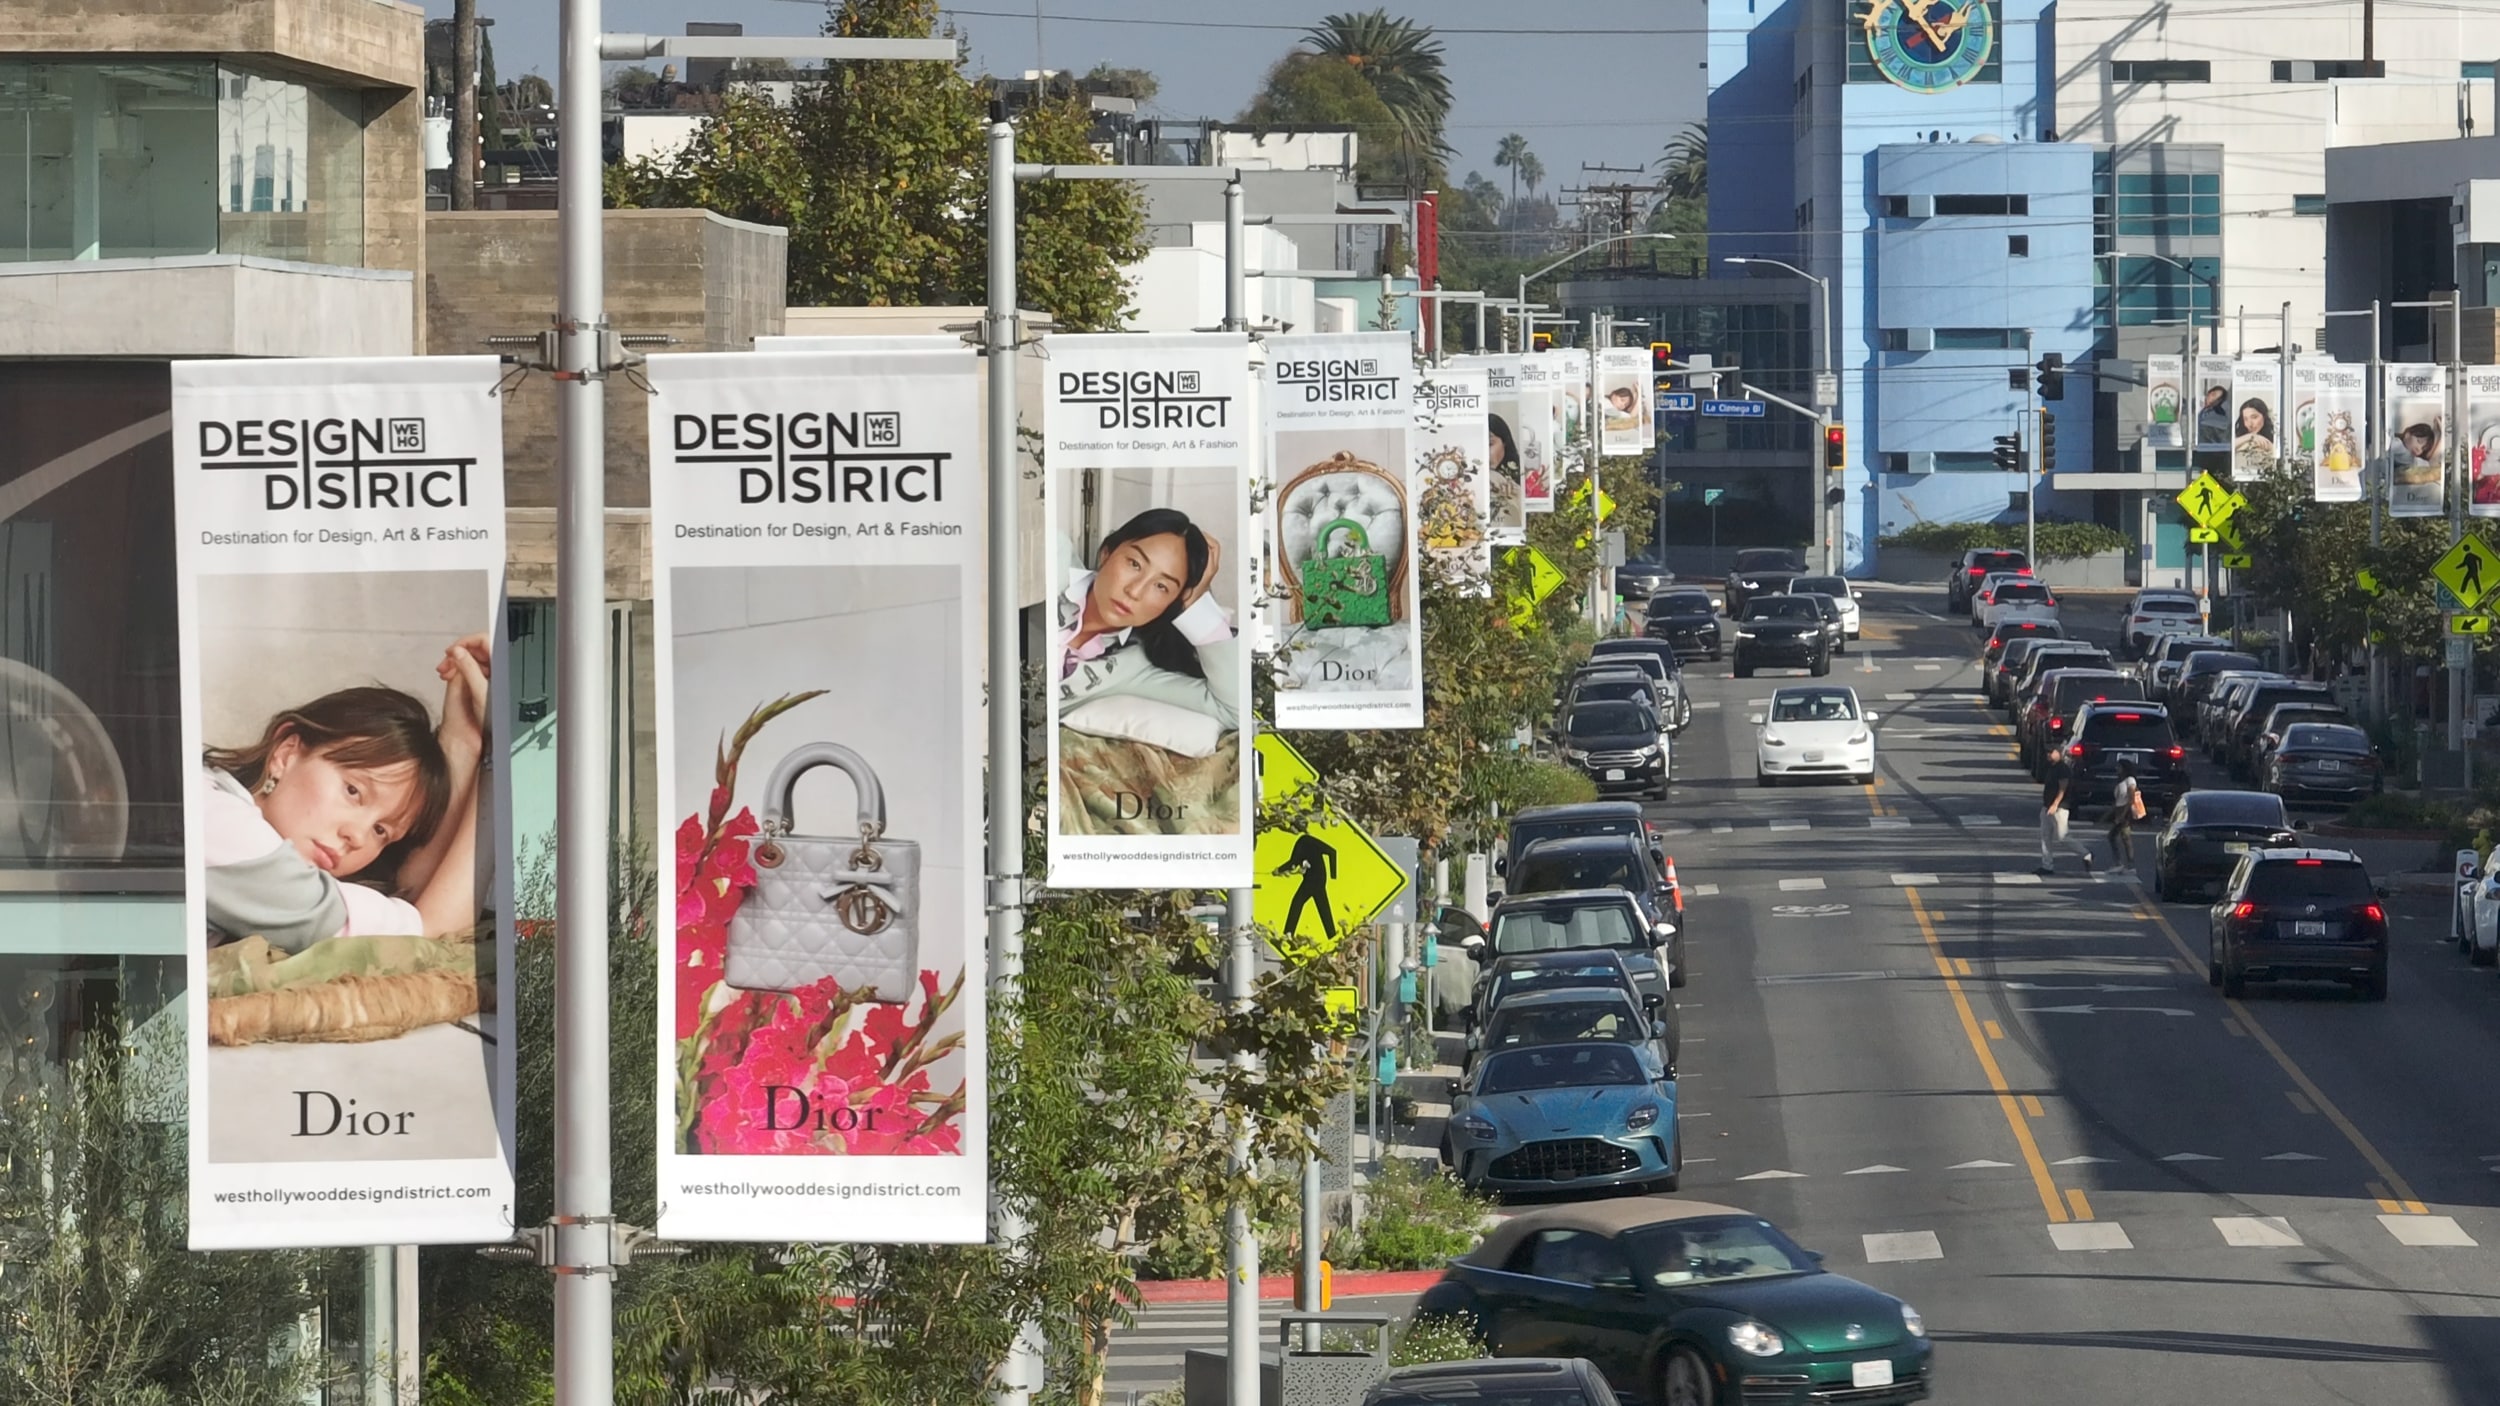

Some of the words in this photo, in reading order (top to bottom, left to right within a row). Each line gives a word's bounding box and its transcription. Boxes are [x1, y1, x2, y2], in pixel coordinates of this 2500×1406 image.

[1180, 374, 1196, 382] WE
[1277, 360, 1359, 378] DESIGN
[1059, 371, 1174, 395] DESIGN
[1182, 382, 1196, 390] HO
[2328, 379, 2361, 388] DISTRICT
[2395, 375, 2427, 384] DESIGN
[2406, 383, 2440, 393] DISTRICT
[1305, 377, 1400, 402] DISTRICT
[1426, 395, 1481, 410] DISTRICT
[1705, 404, 1716, 412] La
[1099, 396, 1232, 429] DISTRICT
[394, 423, 418, 436] WE
[674, 412, 859, 451] DESIGN
[869, 417, 894, 430] WE
[199, 418, 384, 457] DESIGN
[397, 435, 420, 448] HO
[872, 430, 895, 442] HO
[1059, 440, 1114, 450] Destination
[1116, 440, 1129, 450] for
[1132, 440, 1170, 451] Design,
[1172, 439, 1186, 449] Art
[1188, 439, 1196, 449] &
[1200, 438, 1238, 449] Fashion
[265, 457, 477, 510] DISTRICT
[740, 452, 952, 504] DISTRICT
[201, 530, 288, 545] Destination
[293, 529, 314, 543] for
[318, 528, 377, 545] Design,
[383, 527, 405, 542] Art
[410, 527, 421, 541] &
[426, 526, 489, 541] Fashion
[675, 523, 762, 538] Destination
[767, 523, 787, 537] for
[792, 522, 851, 540] Design,
[856, 522, 879, 537] Art
[884, 522, 895, 536] &
[900, 521, 962, 536] Fashion
[1320, 660, 1376, 681] Dior
[1111, 791, 1189, 821] Dior
[1062, 851, 1237, 862] westhollywooddesigndistrict.com
[291, 1090, 415, 1137] Dior
[758, 1085, 883, 1132] Dior
[214, 1186, 491, 1205] westhollywooddesigndistrict.com
[680, 1181, 961, 1200] westhollywooddesigndistrict.com
